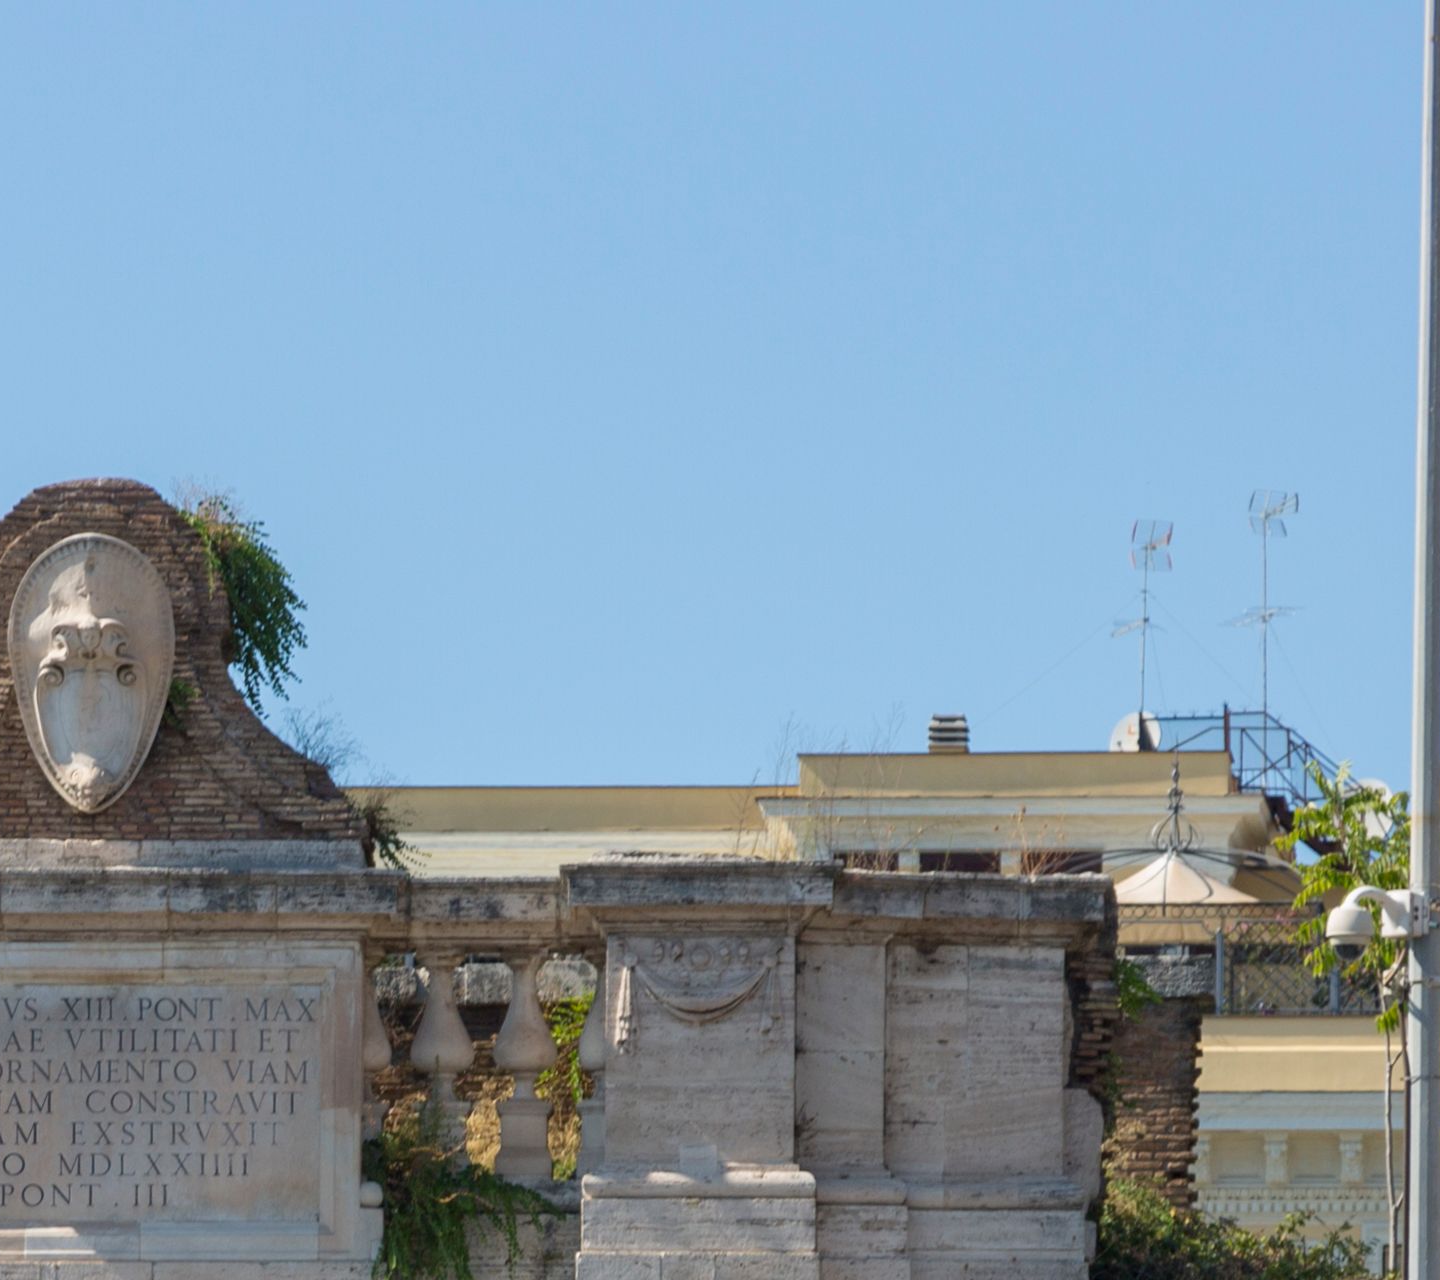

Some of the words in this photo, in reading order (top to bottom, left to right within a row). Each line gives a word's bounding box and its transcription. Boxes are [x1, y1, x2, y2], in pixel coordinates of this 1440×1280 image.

[244, 997, 317, 1023] MAX
[65, 1028, 239, 1053] VTILITATI
[258, 1028, 301, 1053] ET
[223, 1059, 310, 1084] VIAM
[84, 1090, 302, 1116] CONSTRAVIT
[70, 1121, 284, 1147] EXSTRVXIT
[58, 1152, 251, 1178] MDLXXIIII
[132, 1183, 171, 1208] III
